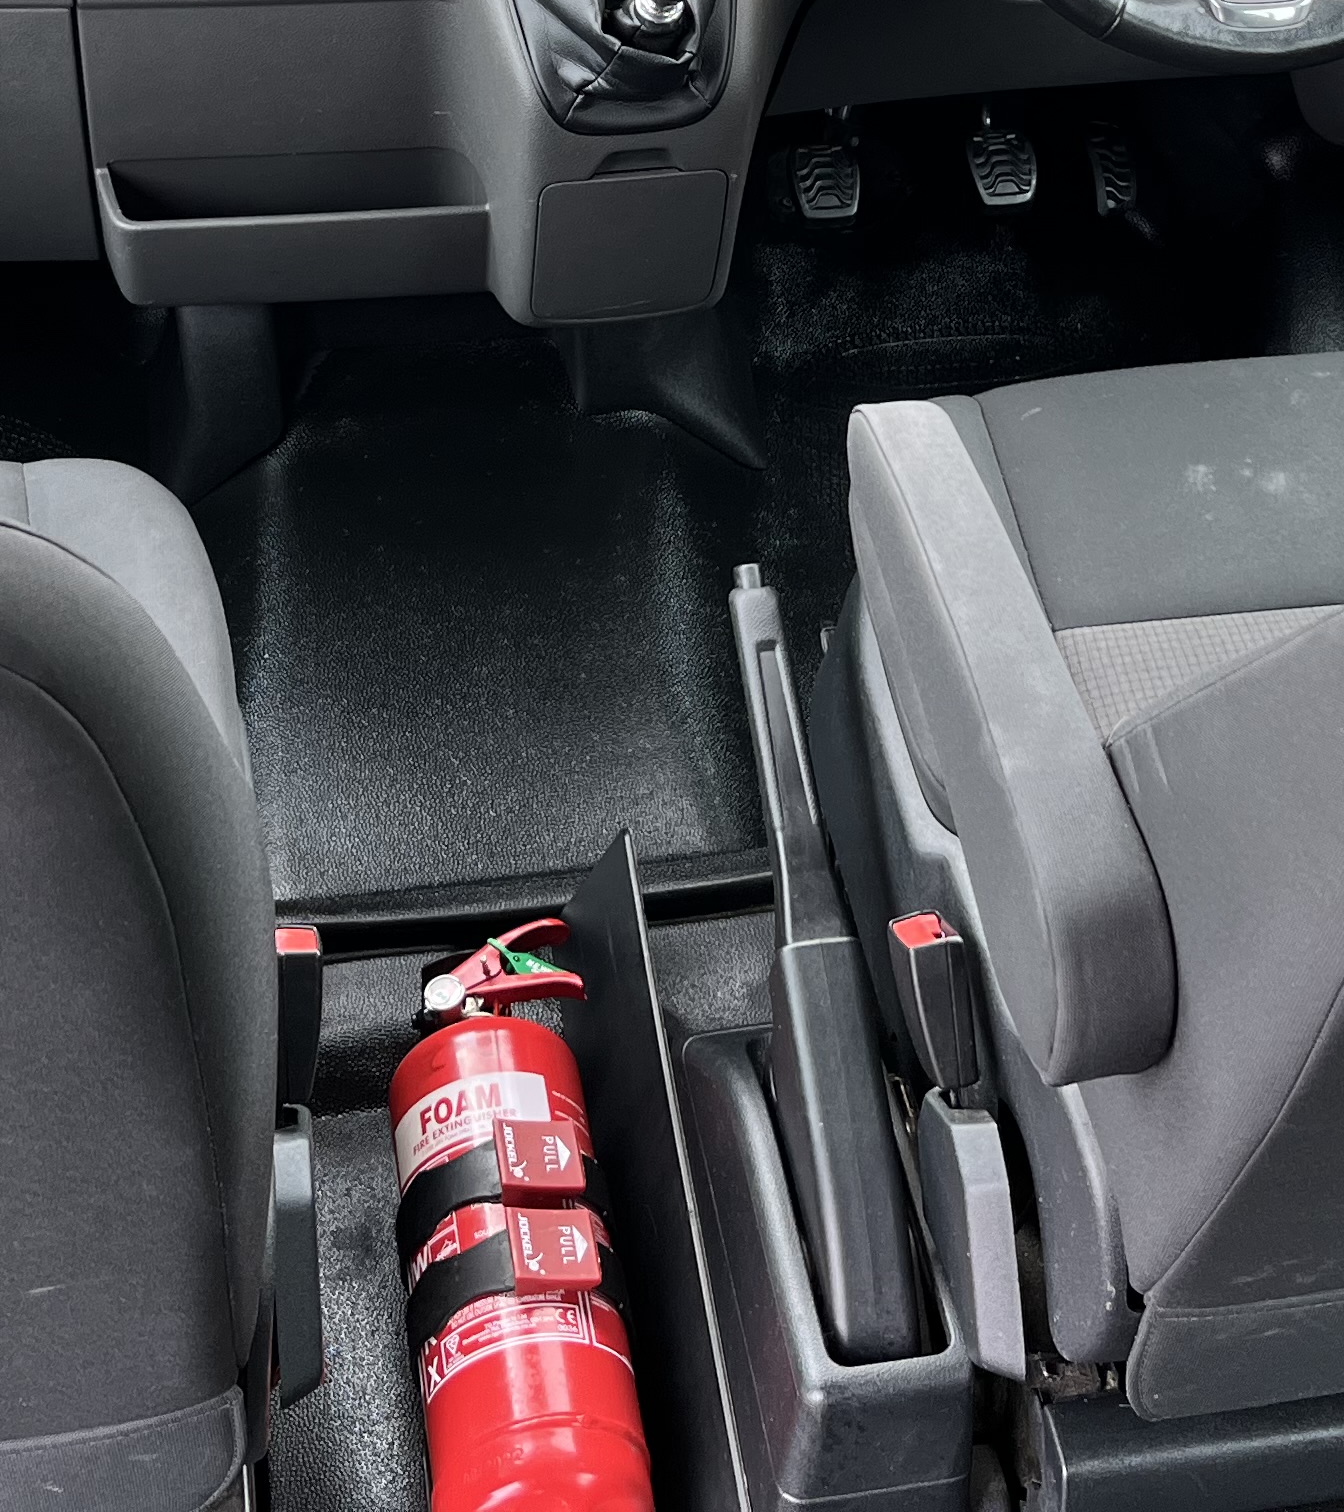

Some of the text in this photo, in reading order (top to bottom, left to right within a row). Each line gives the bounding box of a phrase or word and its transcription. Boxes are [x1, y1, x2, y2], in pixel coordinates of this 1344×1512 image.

[413, 1137, 430, 1157] FIRE
[432, 1108, 519, 1140] EXTINGUISHER
[419, 1082, 502, 1137] FOAM
[503, 1122, 518, 1173] JOCKEL
[541, 1135, 559, 1173] PULL
[517, 1212, 534, 1266] JOCKEL
[558, 1226, 576, 1265] PULL
